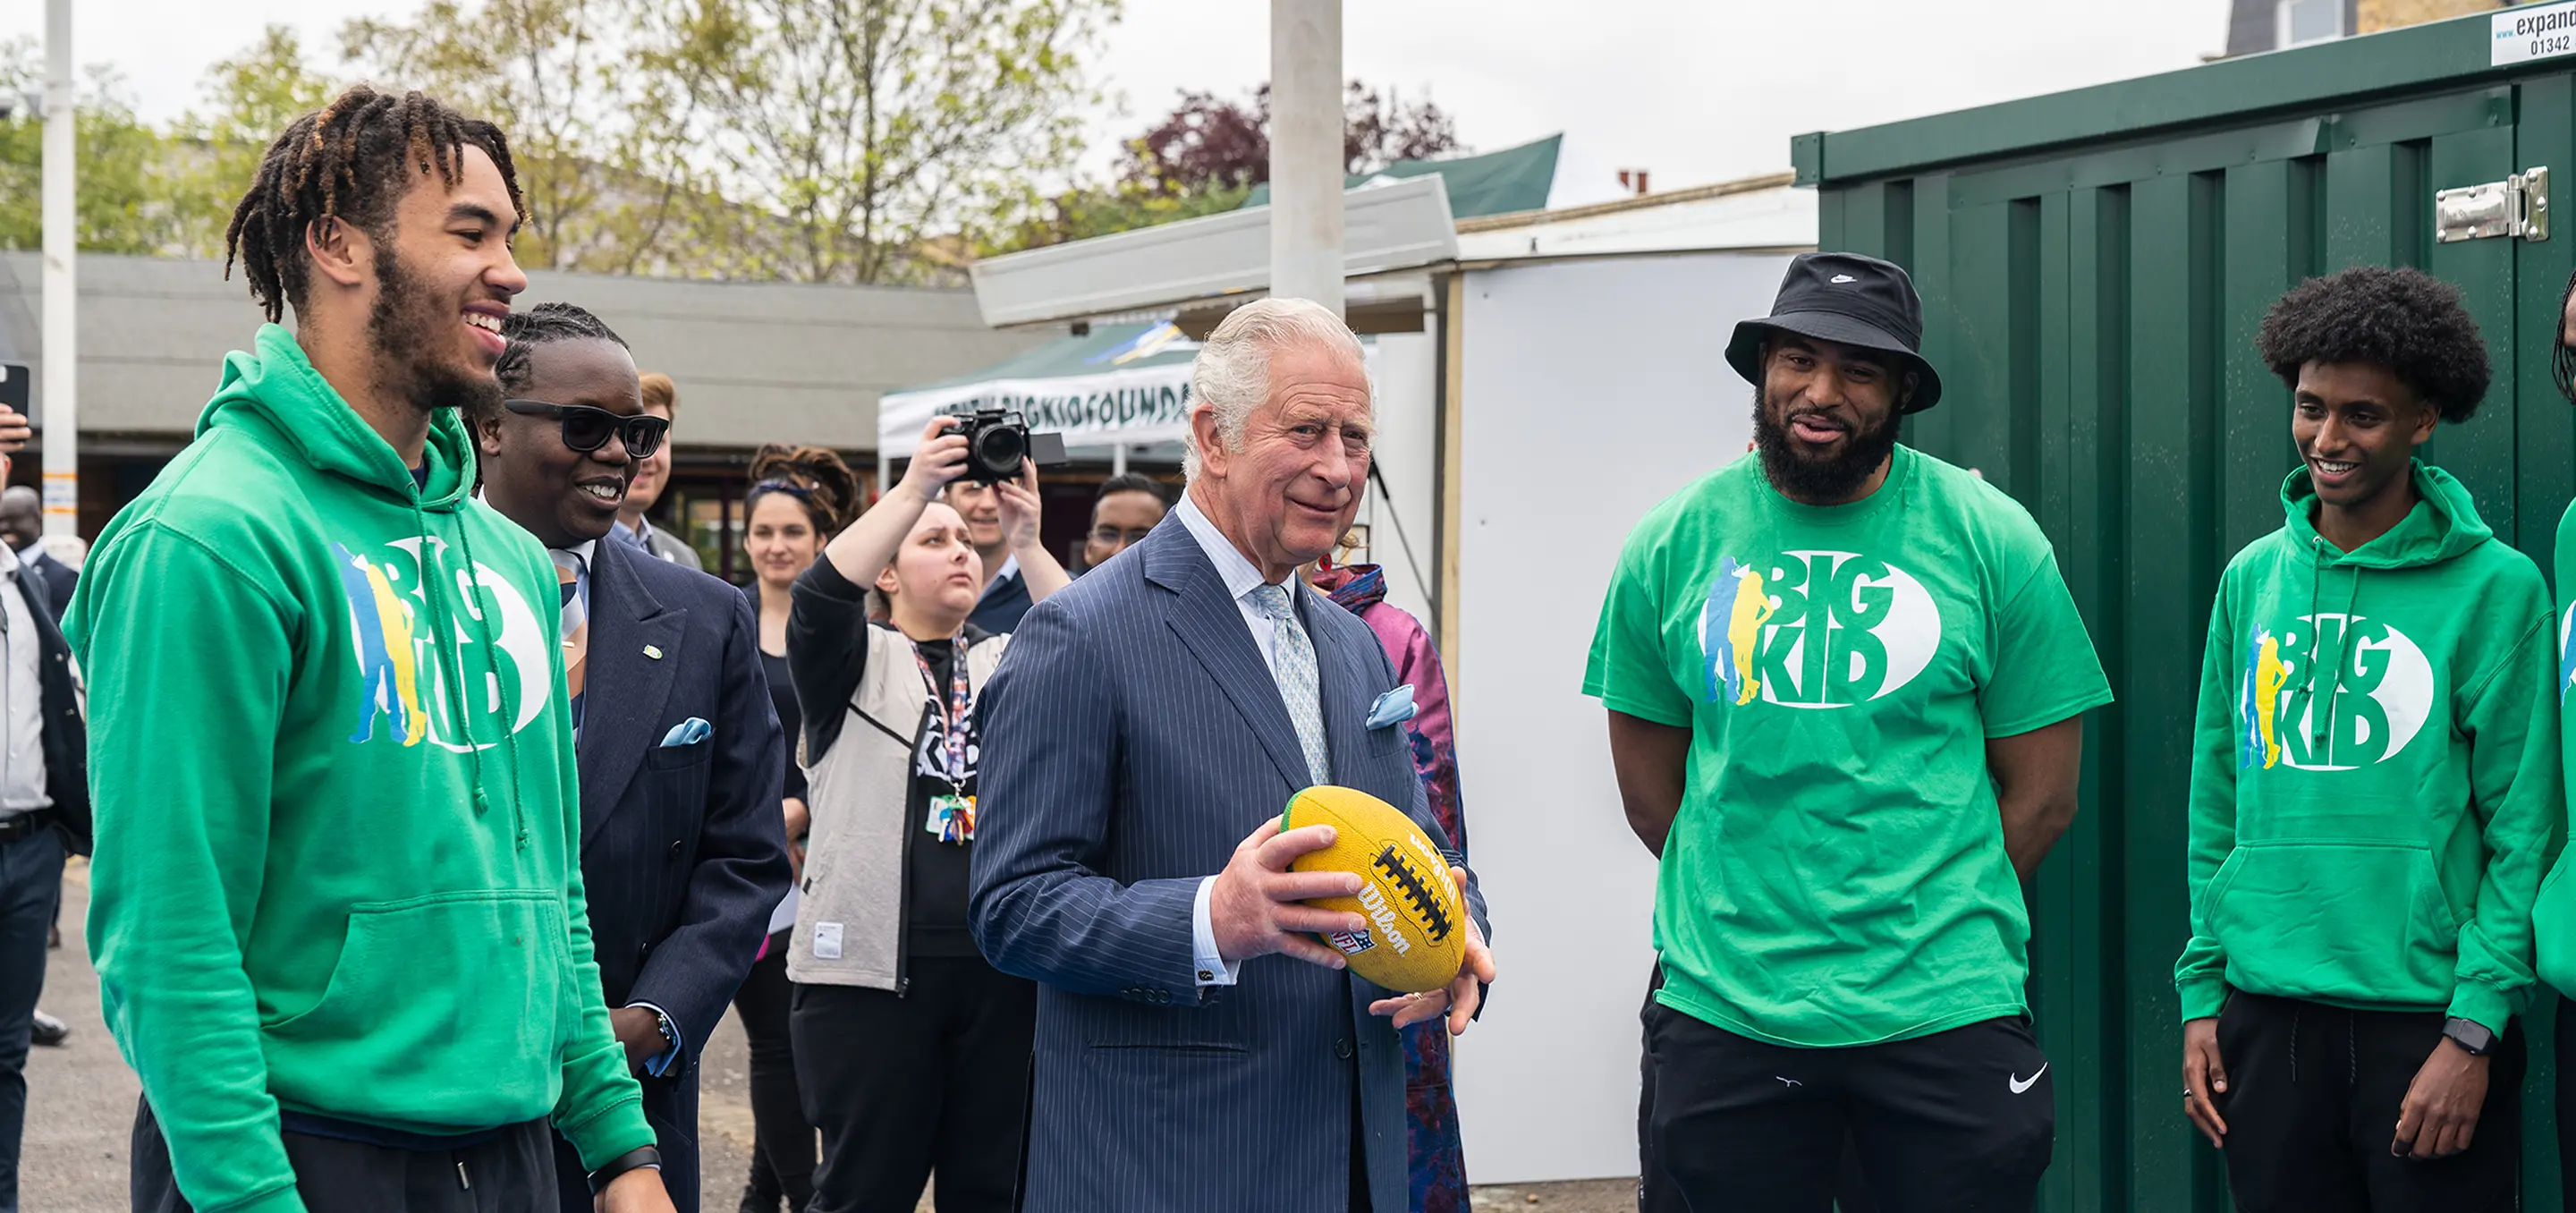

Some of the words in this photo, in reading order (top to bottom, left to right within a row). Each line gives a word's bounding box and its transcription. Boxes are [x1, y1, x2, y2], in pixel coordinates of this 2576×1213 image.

[2530, 36, 2570, 55] 01342
[374, 541, 504, 644] BIG
[1756, 553, 1894, 628] BIG
[1751, 625, 1889, 705] KID
[2275, 617, 2393, 693] BIG
[409, 639, 522, 750] KID
[2273, 691, 2391, 767] KID
[1410, 832, 1456, 905] Wilson
[1358, 880, 1411, 956] Wilson
